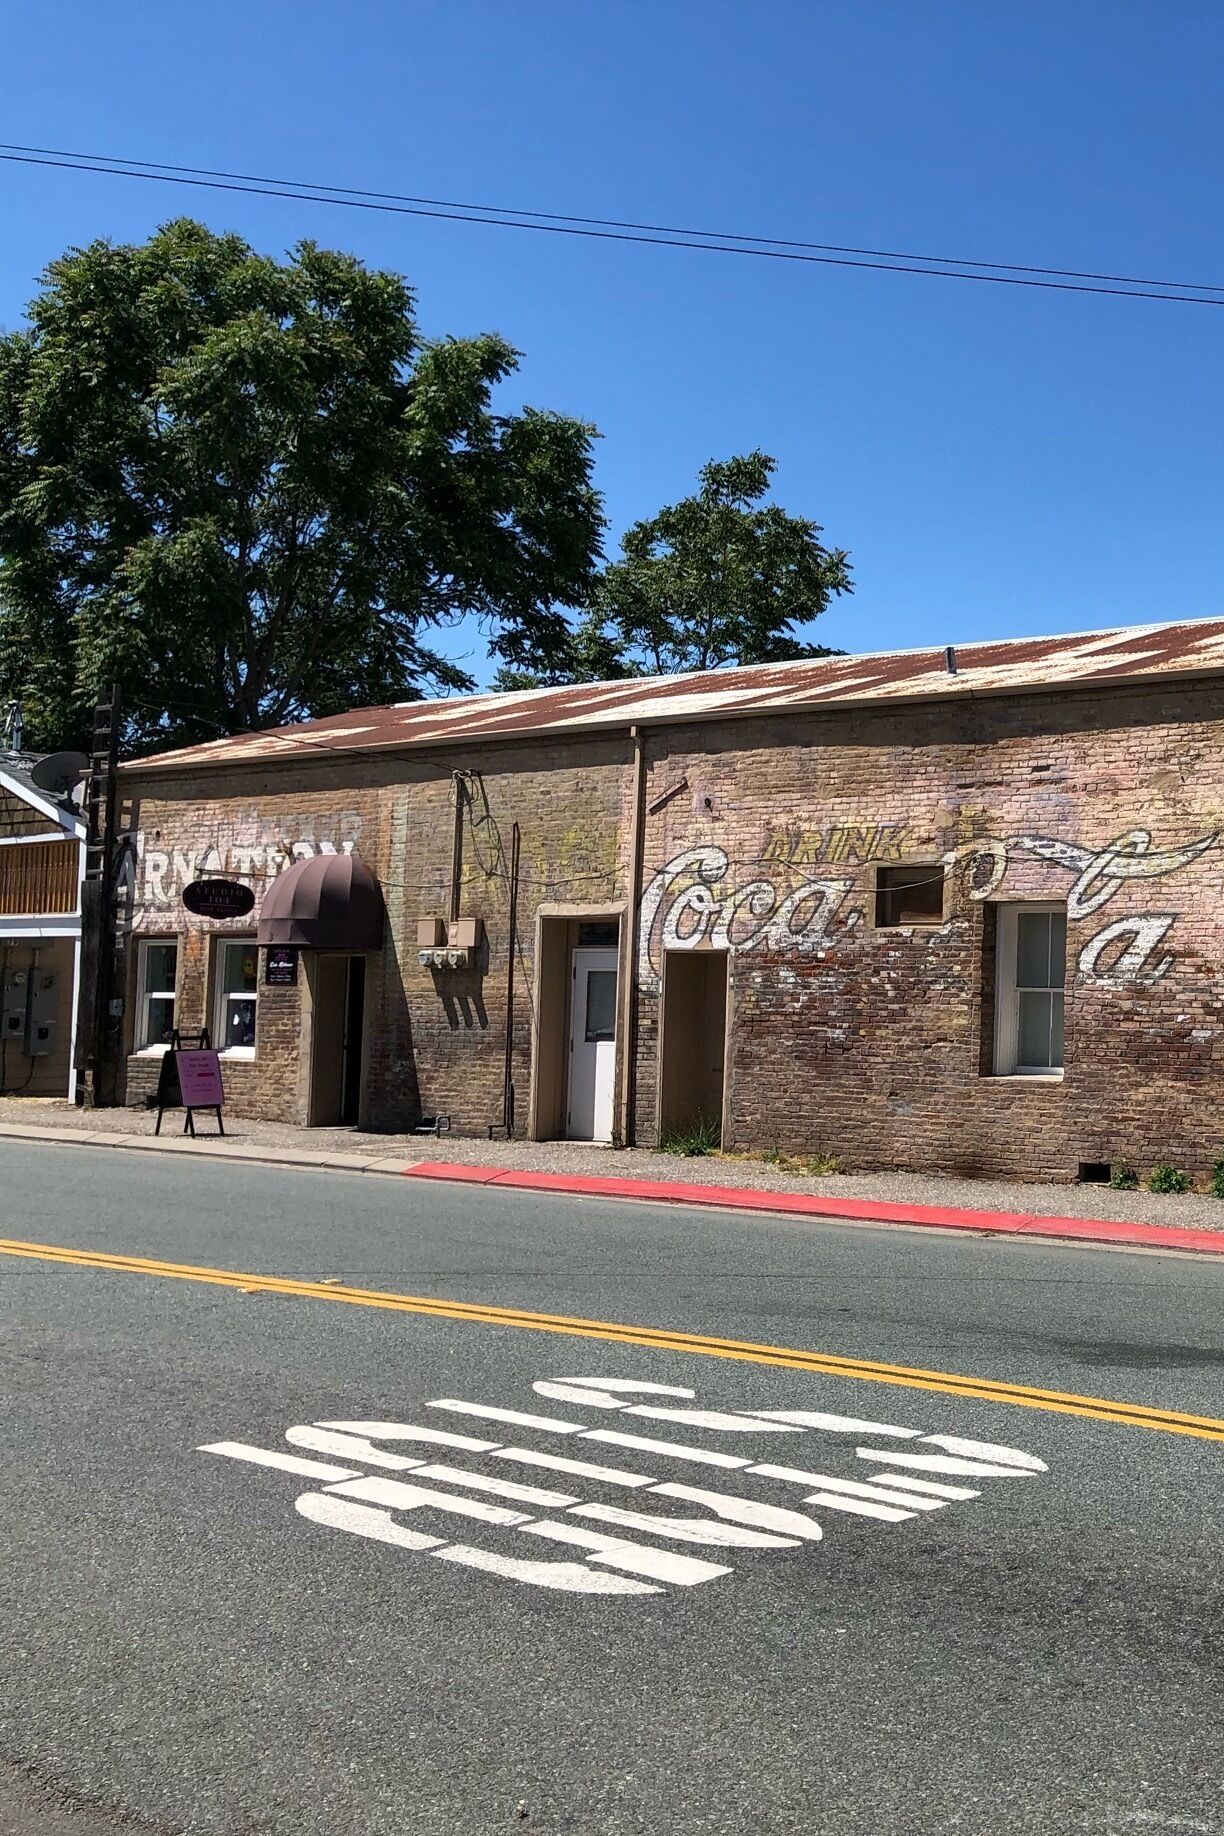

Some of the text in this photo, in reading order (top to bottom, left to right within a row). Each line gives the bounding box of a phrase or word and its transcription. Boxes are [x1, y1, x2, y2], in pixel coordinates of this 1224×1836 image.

[762, 823, 913, 864] DRINK
[196, 886, 243, 897] STUDIO
[196, 1376, 1048, 1596] STOP
